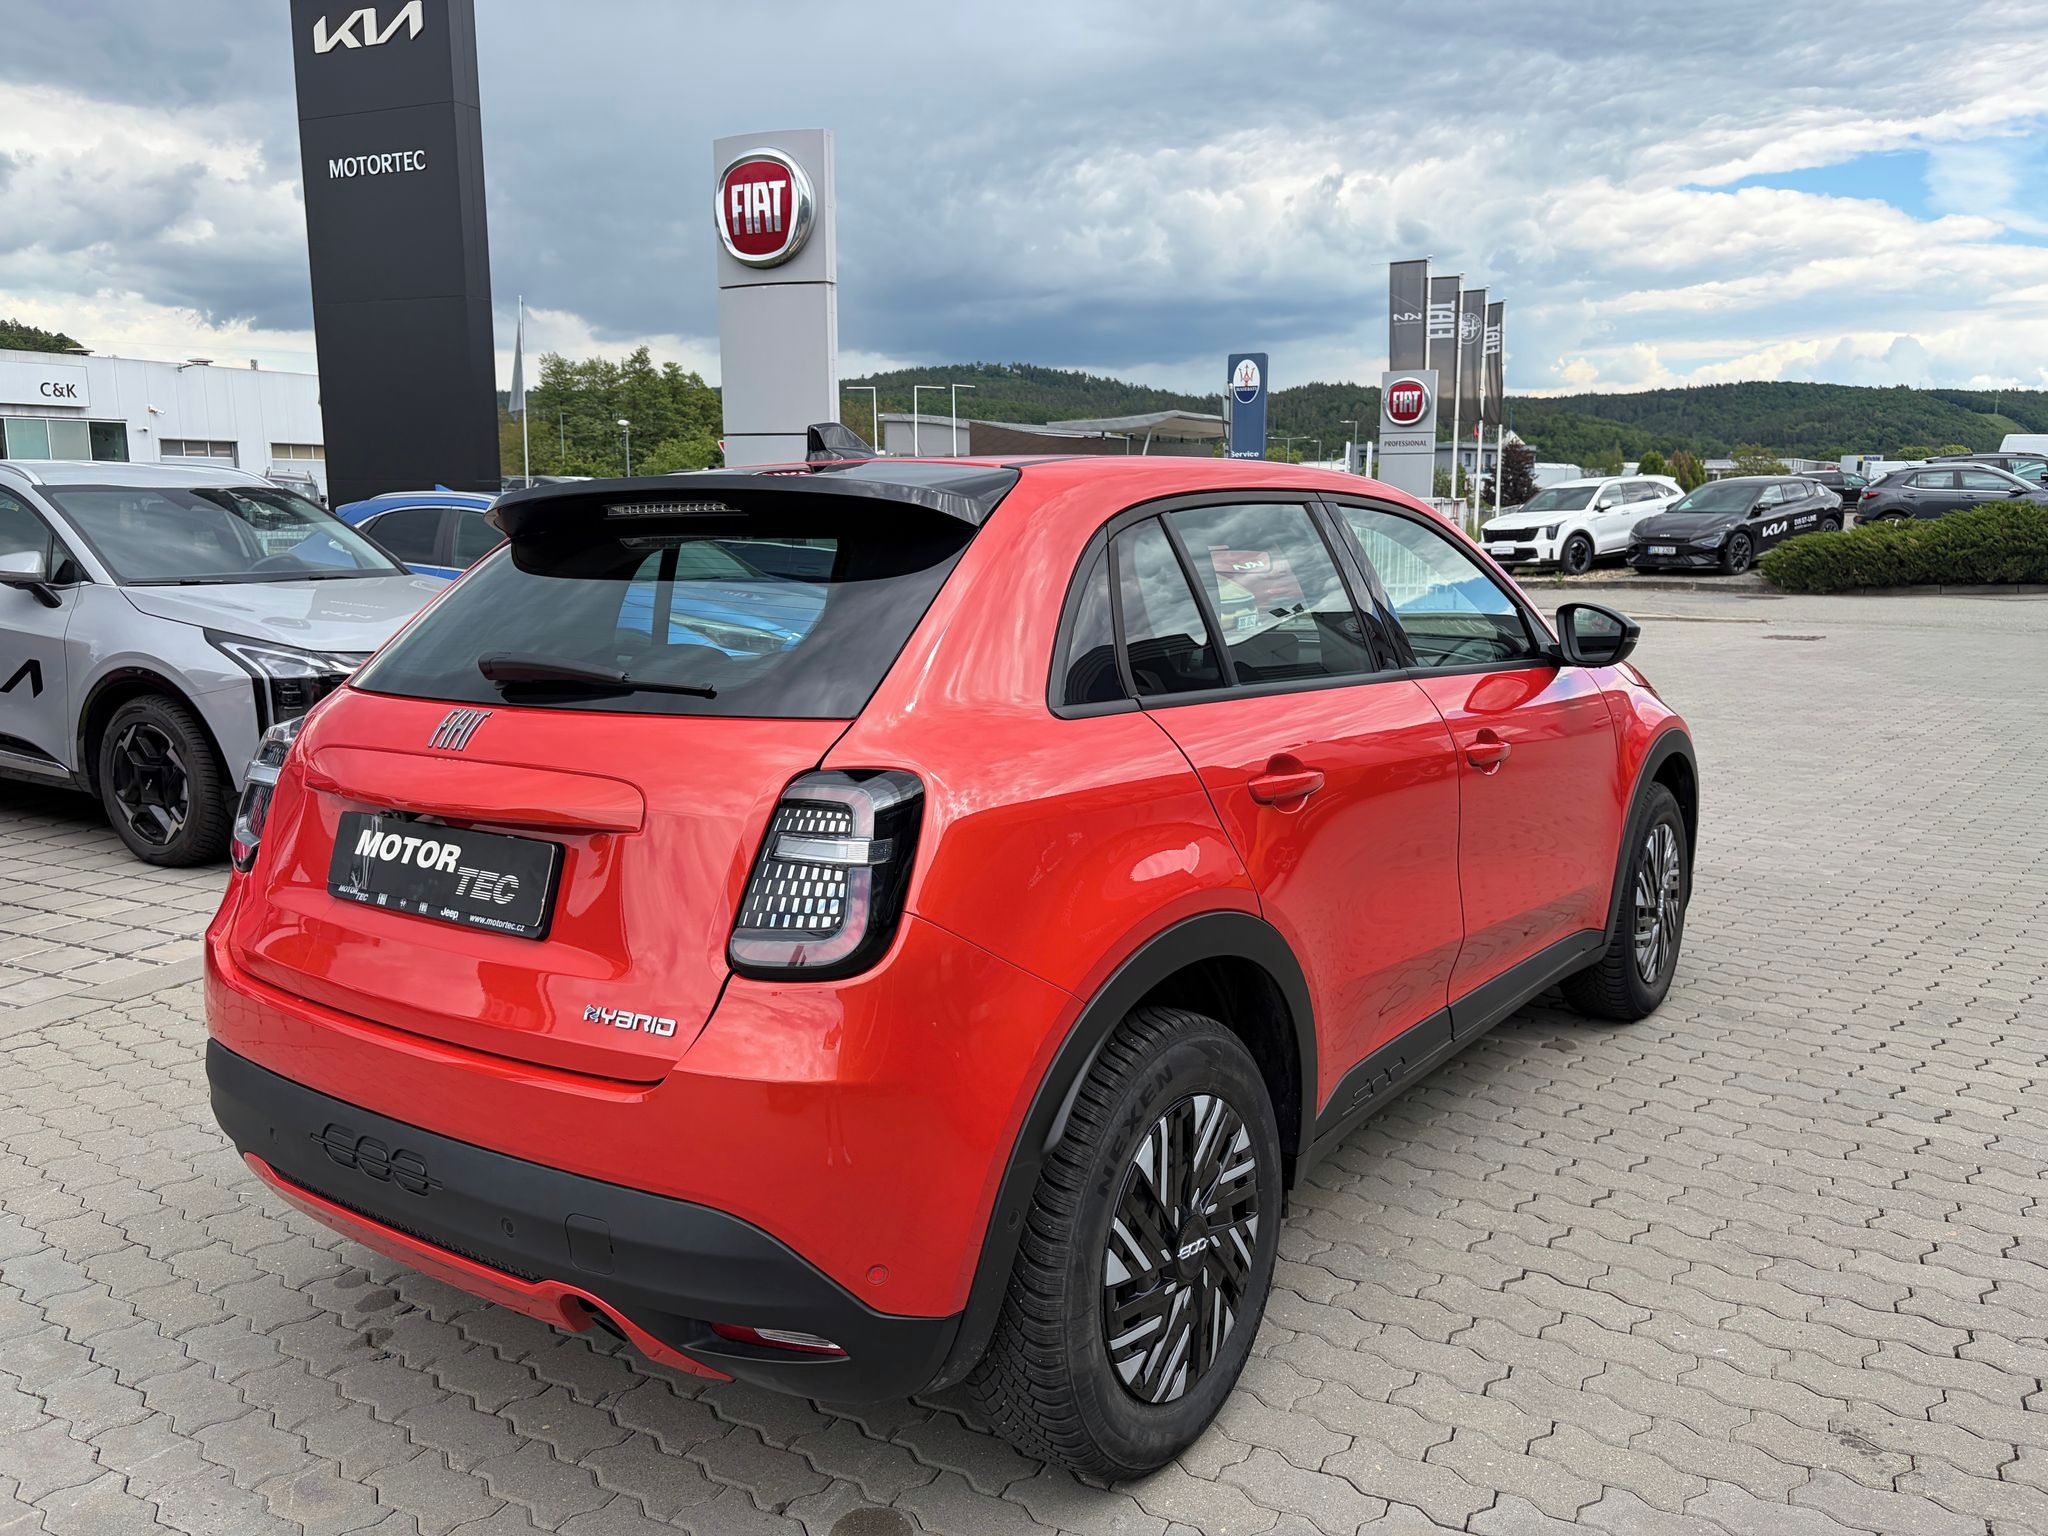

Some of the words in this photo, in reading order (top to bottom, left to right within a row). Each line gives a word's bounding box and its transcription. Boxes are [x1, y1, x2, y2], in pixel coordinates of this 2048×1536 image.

[313, 0, 423, 54] KIA
[328, 150, 427, 179] MOTORTEC
[731, 180, 787, 236] FIAT
[40, 382, 77, 399] C&K
[1392, 390, 1420, 413] FIAT
[1231, 450, 1260, 458] Service
[1762, 520, 1788, 538] KIA
[429, 708, 494, 752] FIAT
[354, 829, 462, 873] MOTOR
[455, 866, 520, 905] TEC
[338, 884, 359, 895] MOTOR
[355, 892, 369, 902] TEC
[440, 906, 459, 920] Jeep
[469, 914, 525, 932] www.motortec.cz
[583, 1004, 677, 1037] HYBRID
[1096, 1063, 1174, 1200] NEXEN
